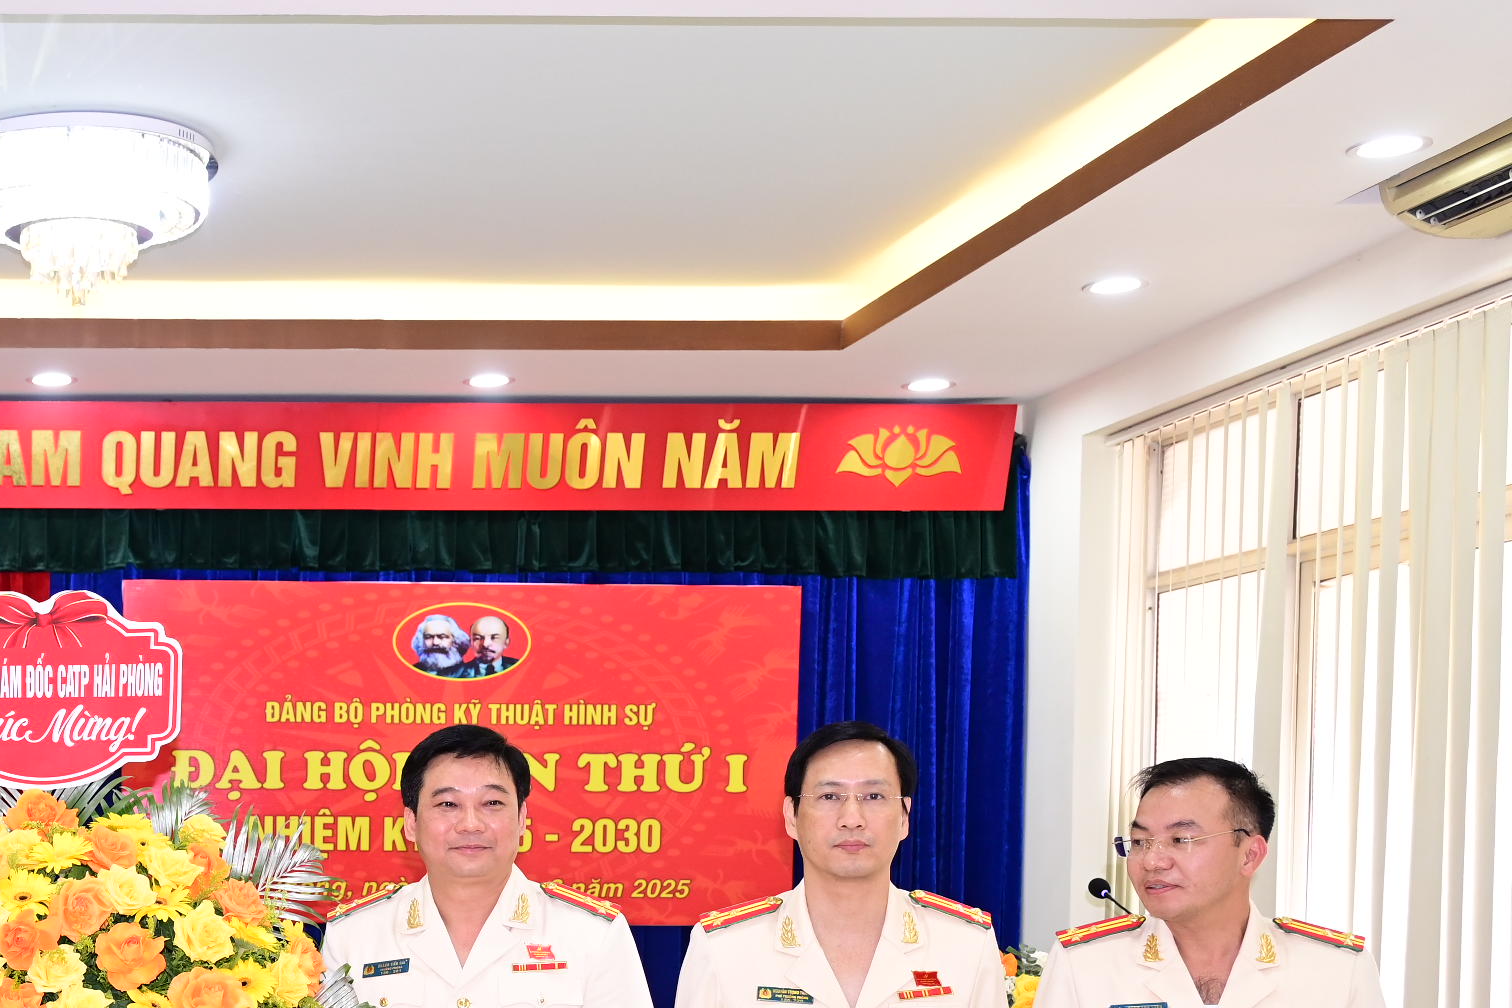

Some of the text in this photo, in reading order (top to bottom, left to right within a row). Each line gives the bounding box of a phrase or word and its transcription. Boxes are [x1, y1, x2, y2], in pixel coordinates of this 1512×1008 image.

[102, 431, 298, 496] QUANG
[320, 432, 457, 490] VINH
[472, 419, 647, 491] MUÔN
[663, 419, 802, 490] NĂM
[25, 652, 54, 699] ĐỐC
[57, 664, 90, 698] CATP
[93, 652, 116, 698] HẢI
[119, 654, 163, 697] PHÒNG
[28, 704, 147, 753] Mừng!
[265, 695, 658, 730] ĐẢNG BỘ PHÒNG KỸ THUẬT HÌNH SỰ
[170, 749, 286, 801] ĐẠI
[577, 742, 713, 794] THỨ
[725, 753, 750, 794] I
[570, 818, 663, 855] 2030
[631, 878, 692, 899] 2025
